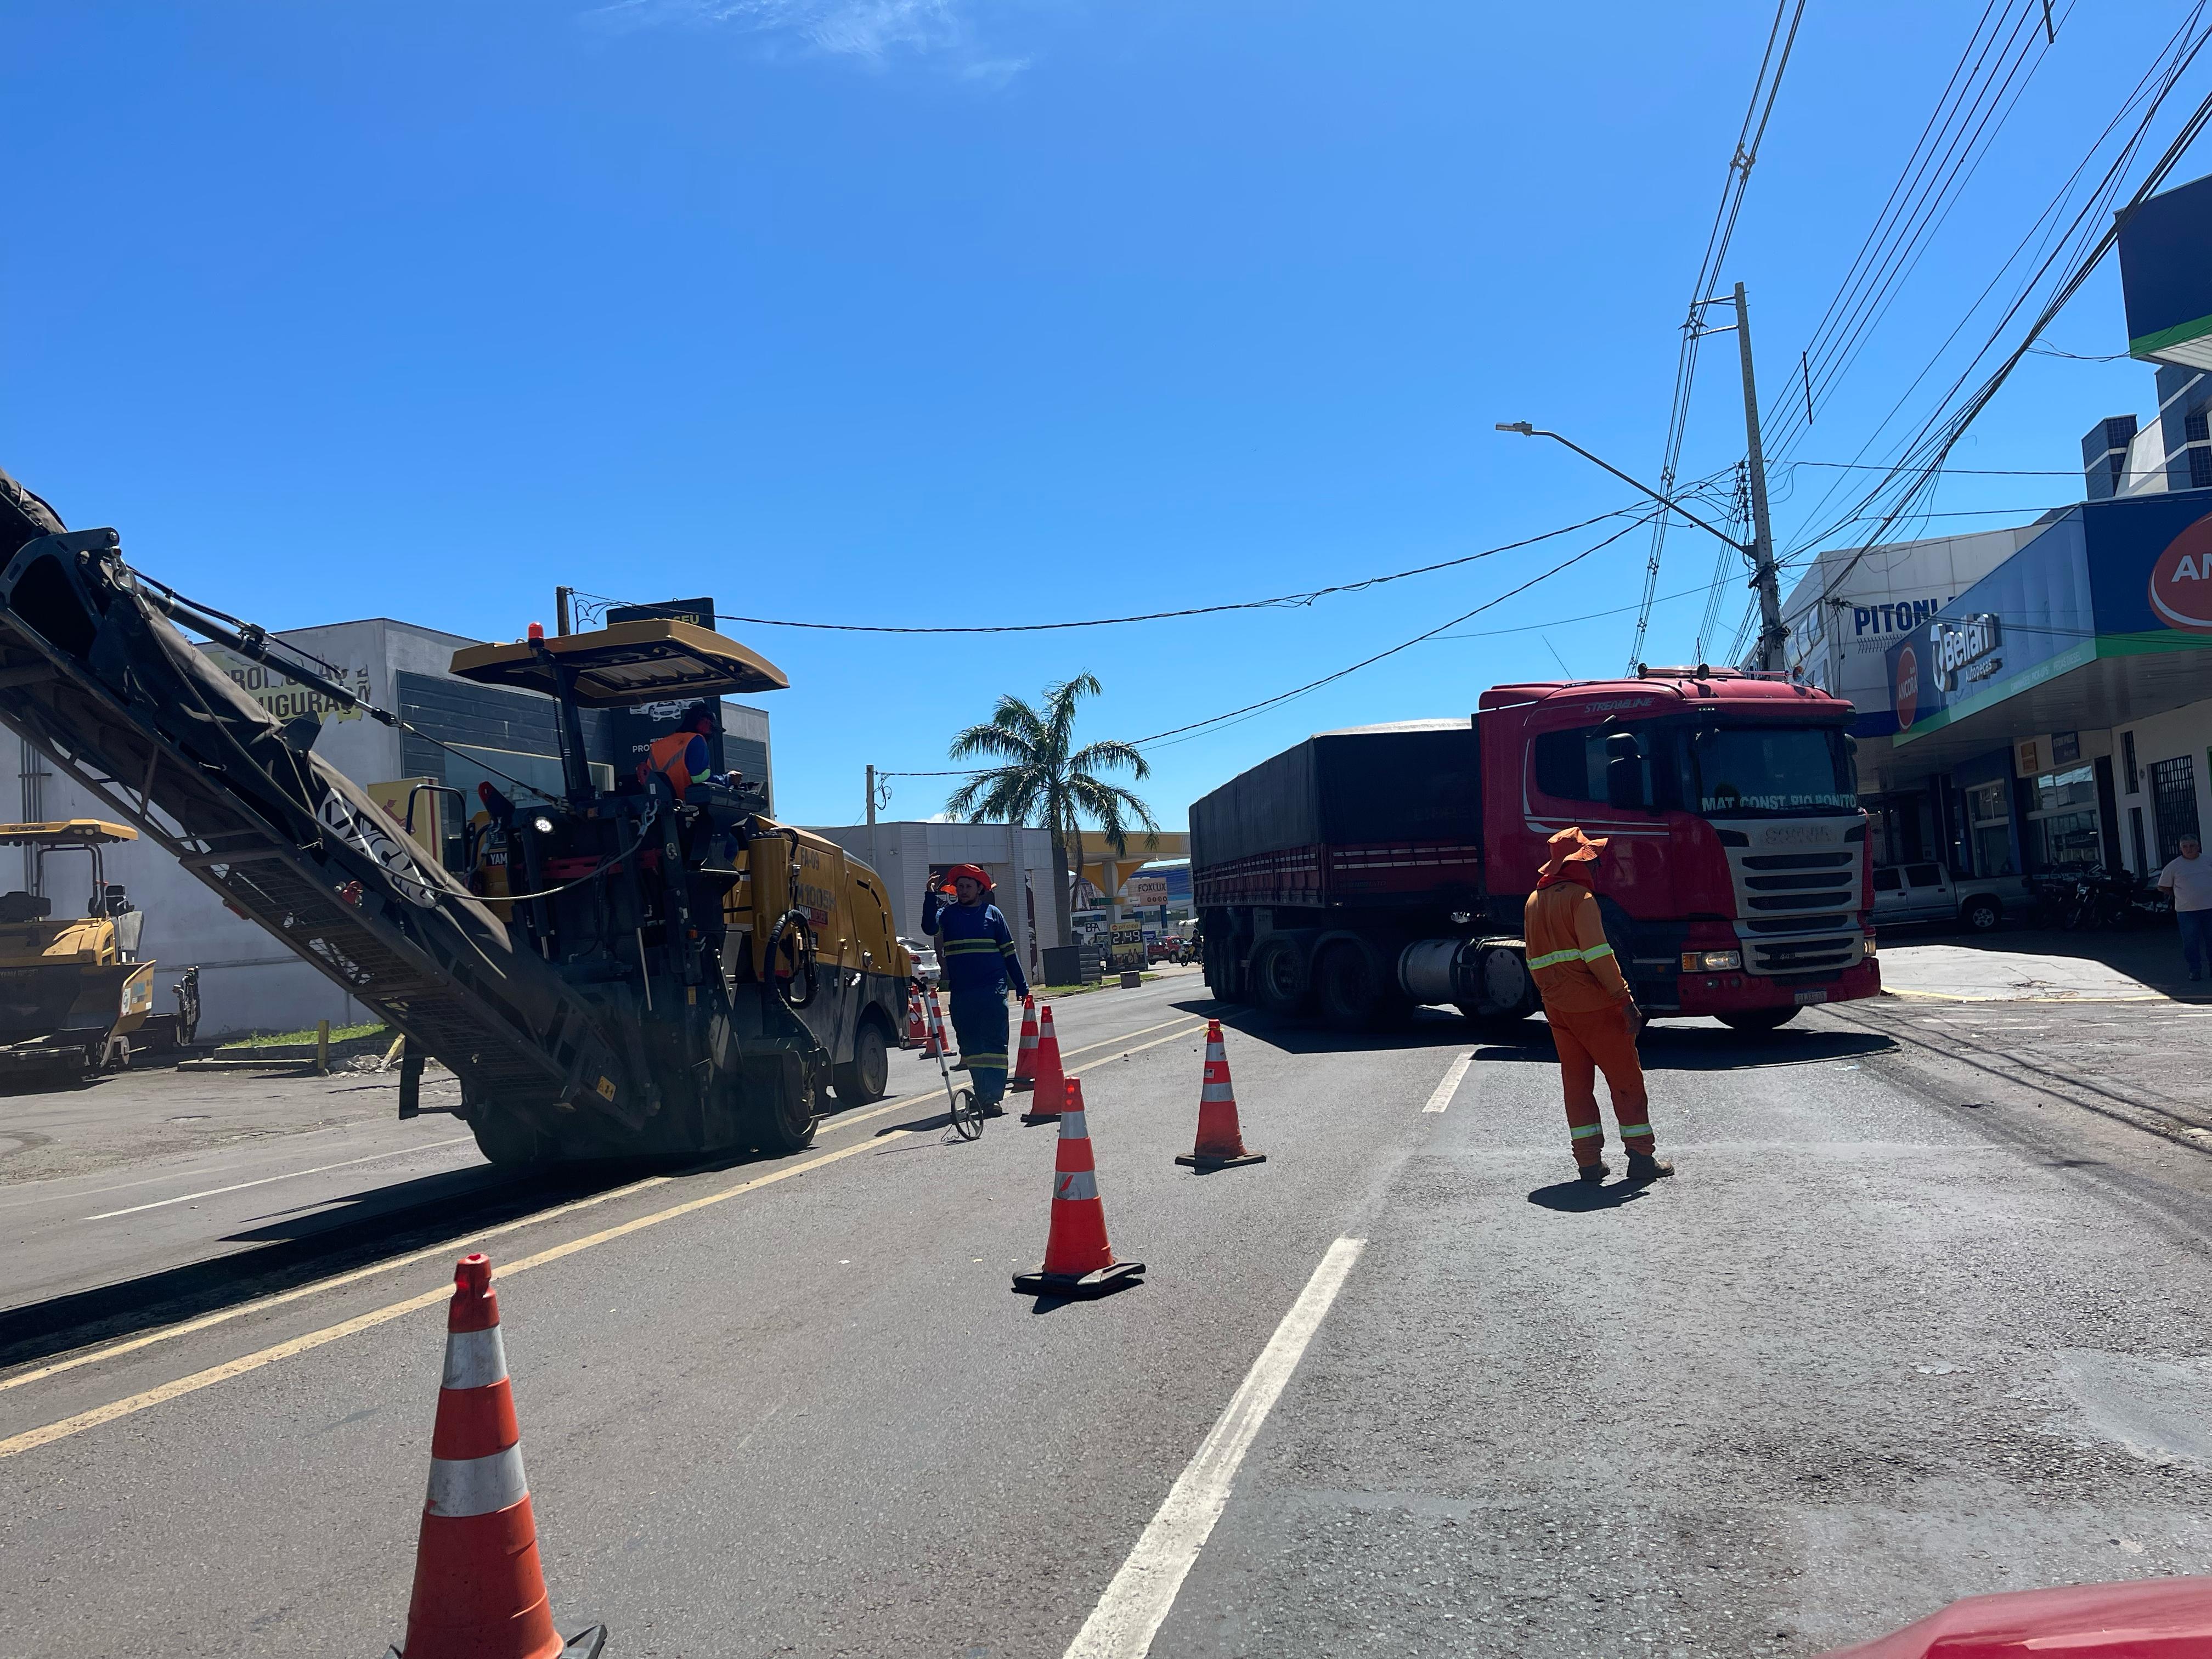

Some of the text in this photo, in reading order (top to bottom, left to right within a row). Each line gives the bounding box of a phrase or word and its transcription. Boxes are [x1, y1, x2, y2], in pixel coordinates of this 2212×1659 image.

[1944, 613, 1989, 672] Bellan
[1898, 674, 1919, 702] ANCORA
[490, 853, 508, 865] YAM
[1138, 882, 1166, 892] FOXLUX
[1113, 930, 1141, 944] 2.49
